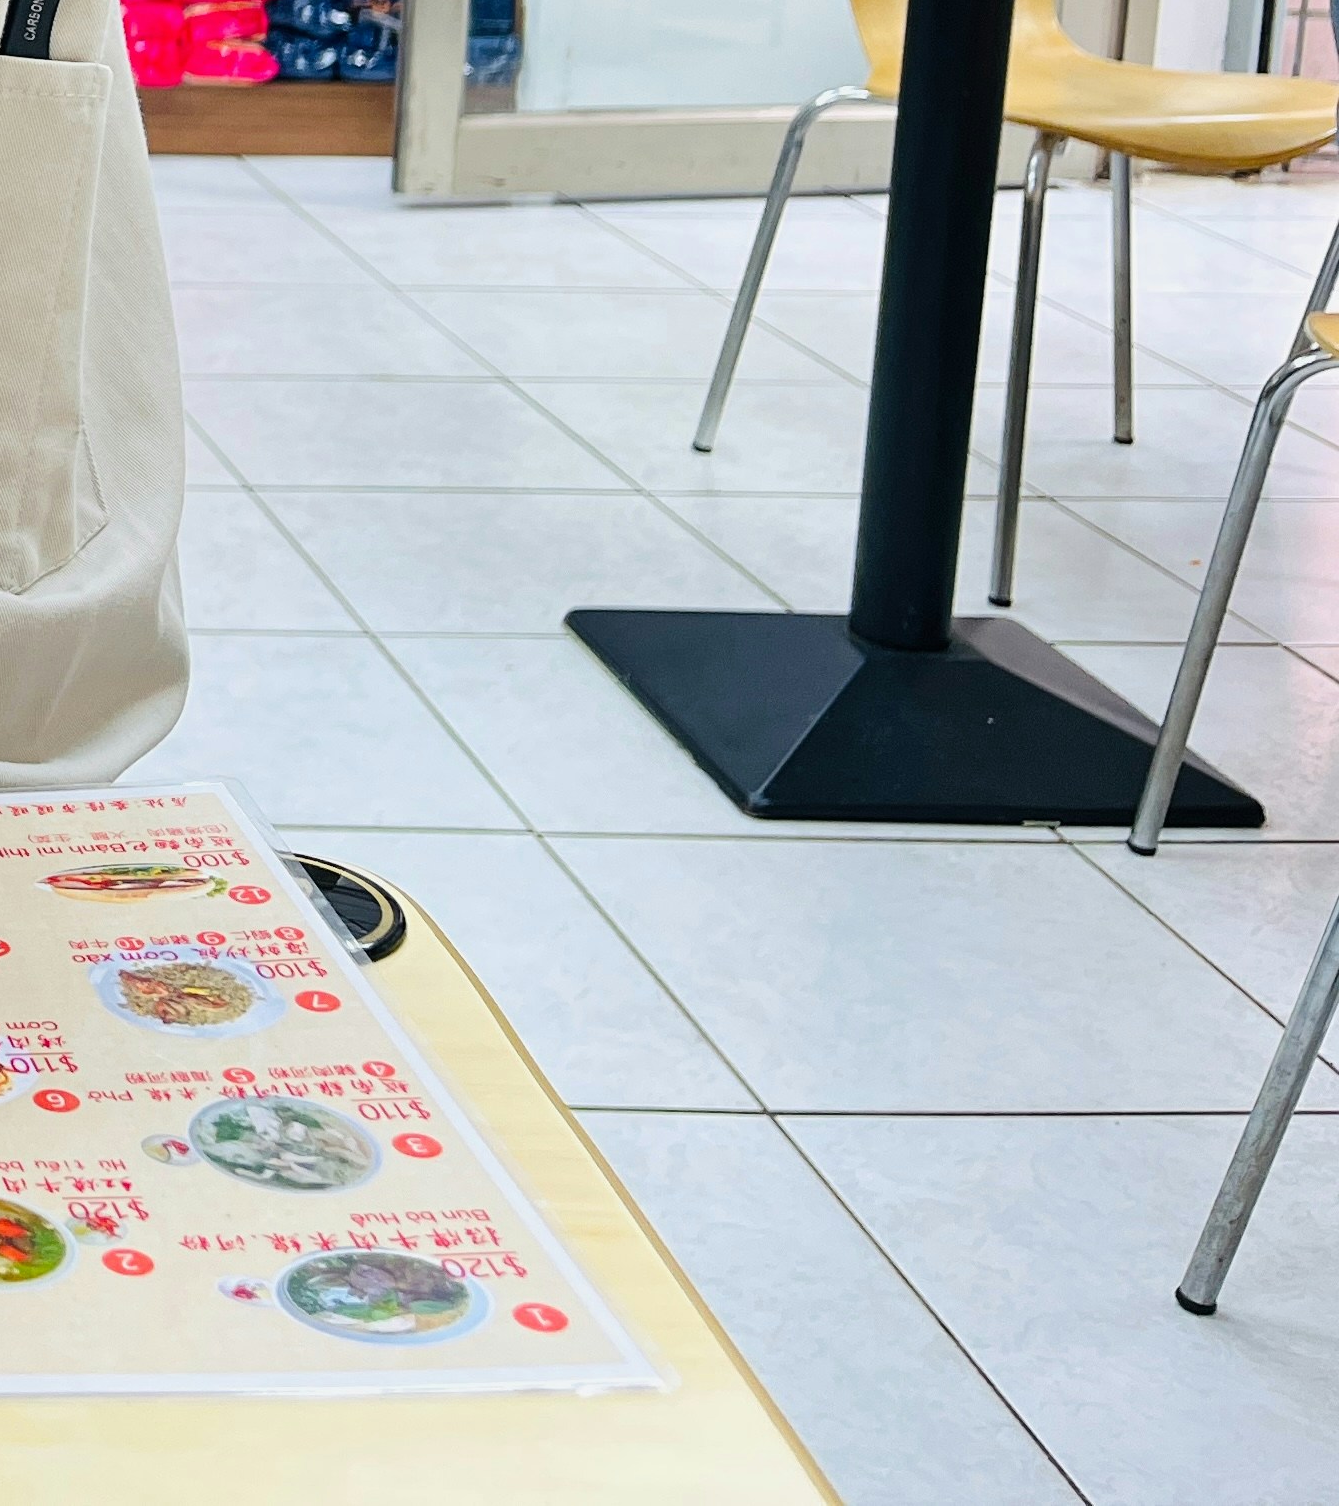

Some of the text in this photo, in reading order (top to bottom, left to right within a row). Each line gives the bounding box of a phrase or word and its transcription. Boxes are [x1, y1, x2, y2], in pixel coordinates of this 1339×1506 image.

[183, 848, 250, 869] $100
[69, 941, 108, 950] 牛肉
[192, 941, 309, 960] 海鮮炒飯
[71, 951, 115, 966] xào
[256, 958, 328, 980] $100
[10, 1054, 78, 1074] $110
[357, 1098, 431, 1121] $110
[68, 1199, 148, 1221] $120
[406, 1211, 433, 1223] bò
[442, 1254, 528, 1279] $120
